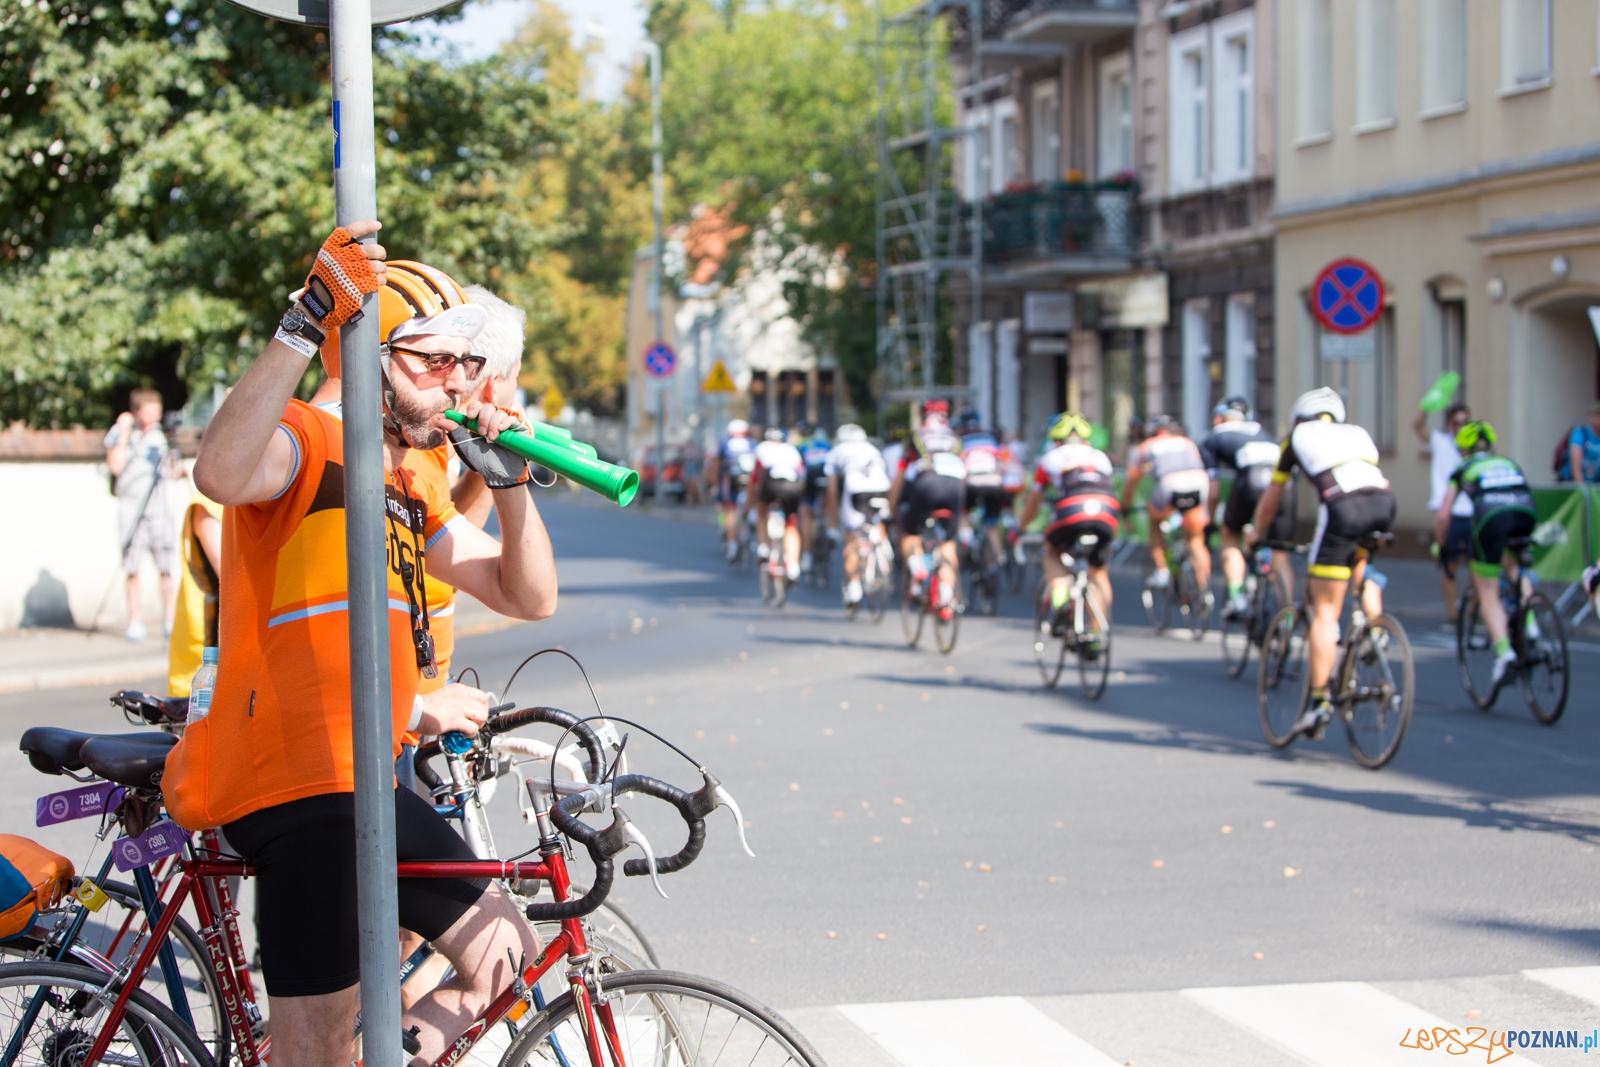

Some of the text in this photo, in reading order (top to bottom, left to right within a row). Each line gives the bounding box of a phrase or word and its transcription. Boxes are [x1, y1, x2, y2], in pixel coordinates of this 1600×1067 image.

[385, 493, 415, 528] intag
[79, 792, 101, 806] 7304
[400, 961, 414, 980] NE
[207, 941, 253, 1062] Helyett
